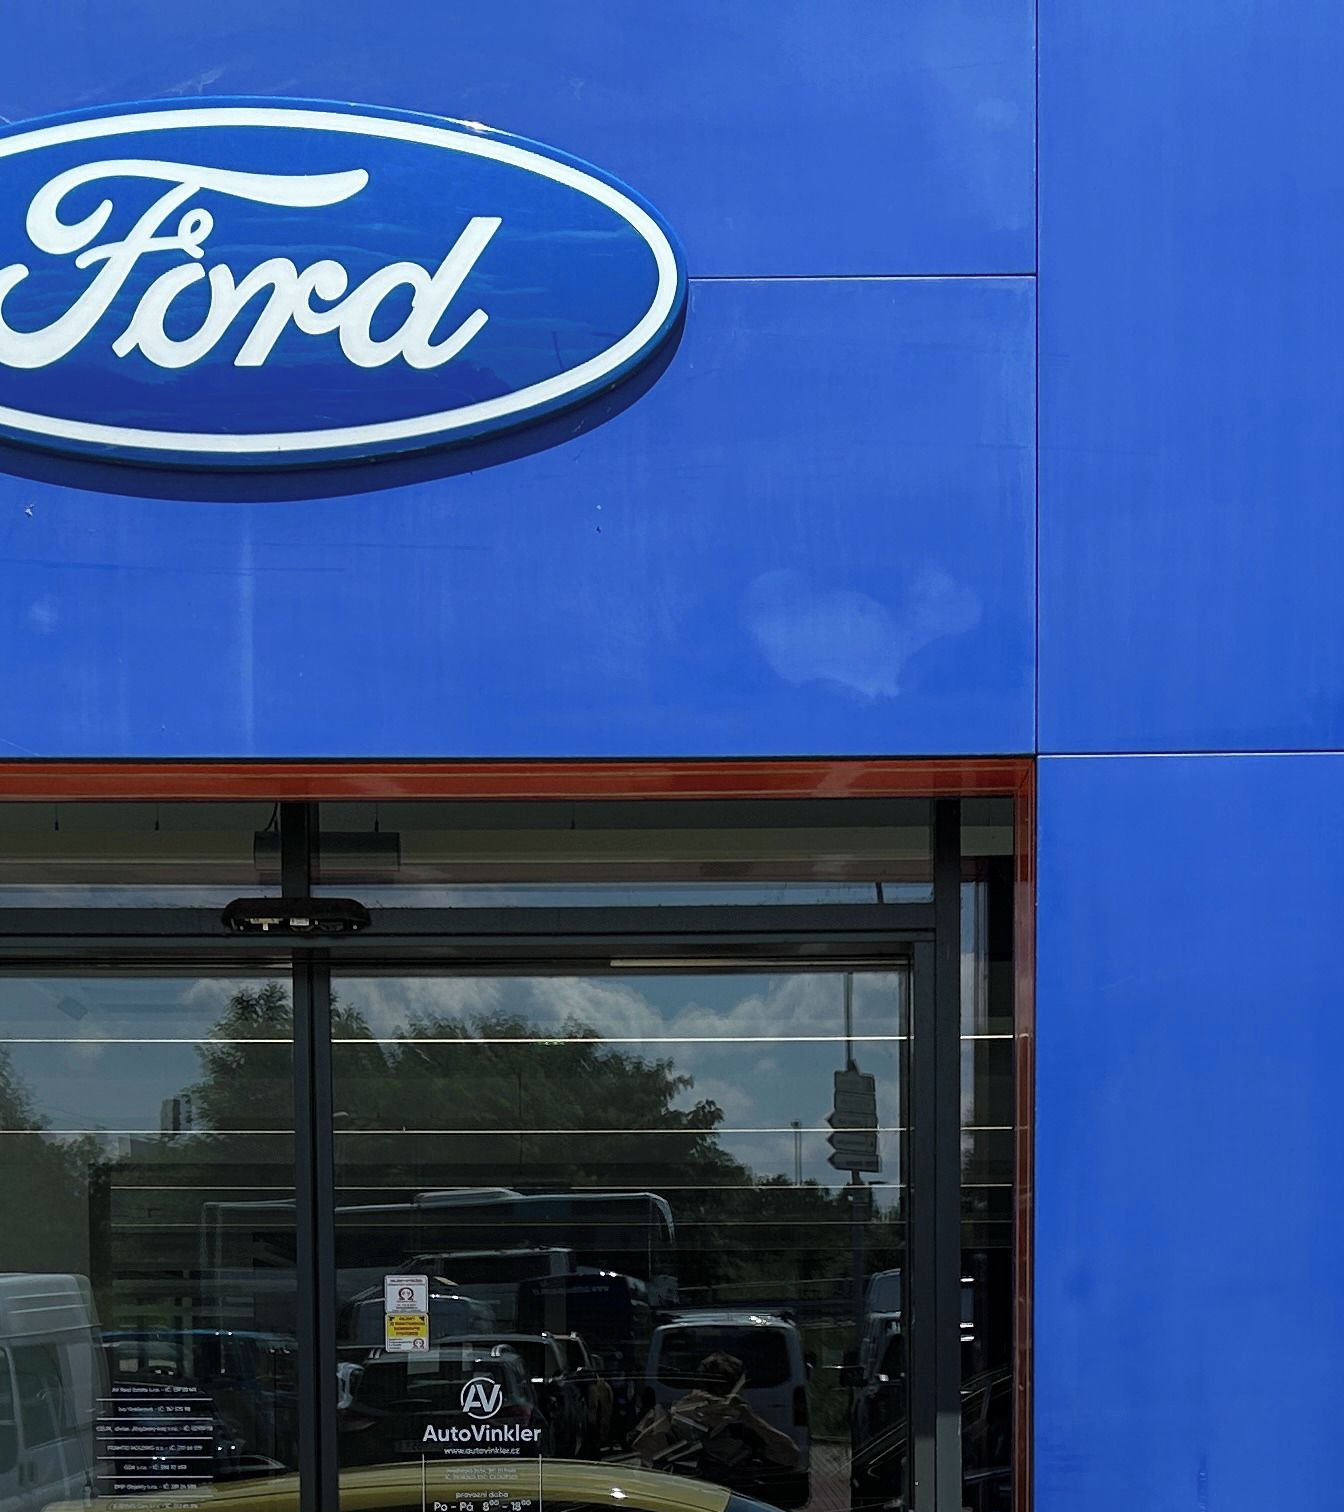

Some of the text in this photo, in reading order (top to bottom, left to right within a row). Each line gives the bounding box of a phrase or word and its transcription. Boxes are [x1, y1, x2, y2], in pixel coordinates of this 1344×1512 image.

[422, 1424, 542, 1442] AutoVinkler
[488, 1490, 509, 1498] doba
[433, 1502, 448, 1511] Po
[459, 1501, 474, 1511] Pá
